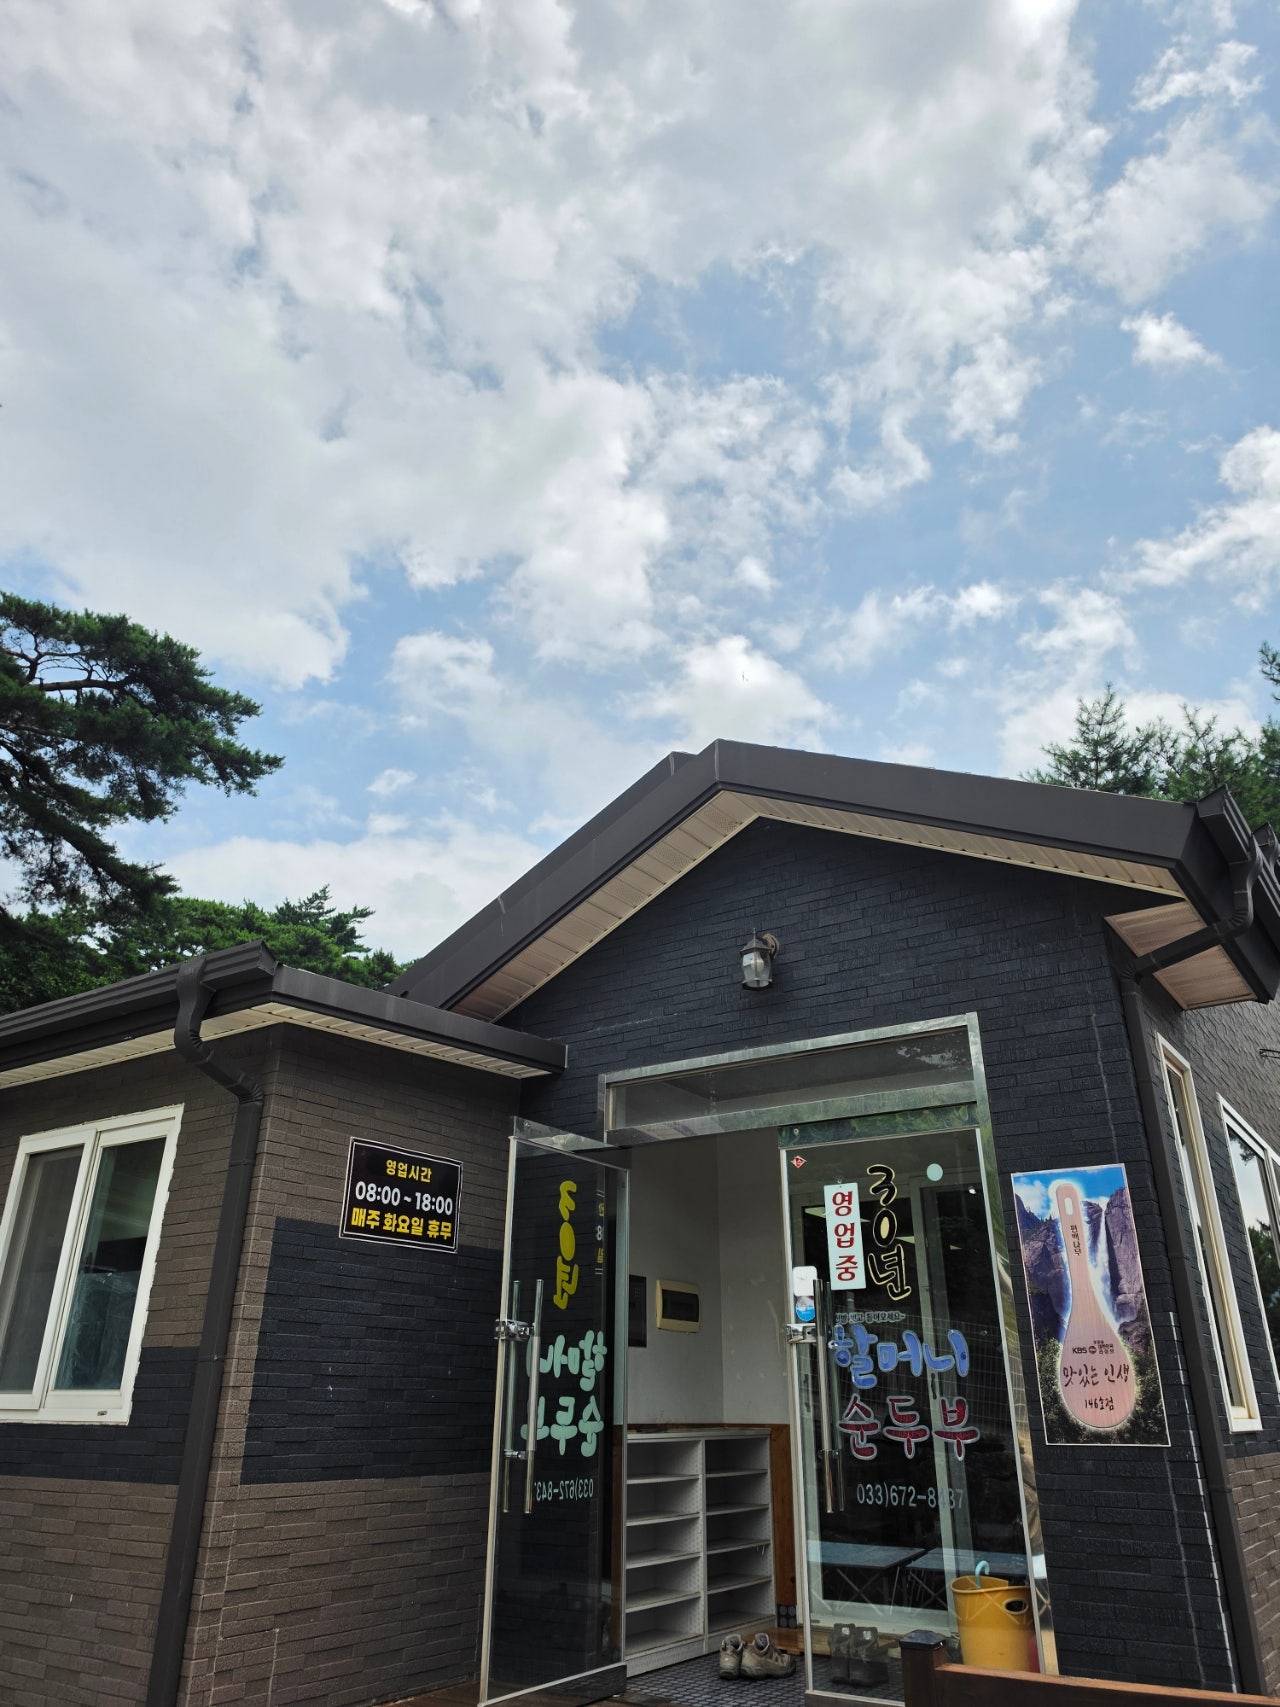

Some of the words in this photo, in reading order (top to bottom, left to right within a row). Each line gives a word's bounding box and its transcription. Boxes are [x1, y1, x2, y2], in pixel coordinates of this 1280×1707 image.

[386, 1159, 432, 1183] 영업시간
[351, 1207, 380, 1229] 매주
[383, 1212, 424, 1236] 화요일
[427, 1219, 452, 1240] 휴무
[832, 1191, 858, 1282] 영업중
[828, 1324, 969, 1389] 할머니
[1063, 1364, 1099, 1388] 맛있는
[1104, 1364, 1129, 1383] 인생
[1084, 1396, 1114, 1411] 146호점
[836, 1393, 980, 1461] 순두부
